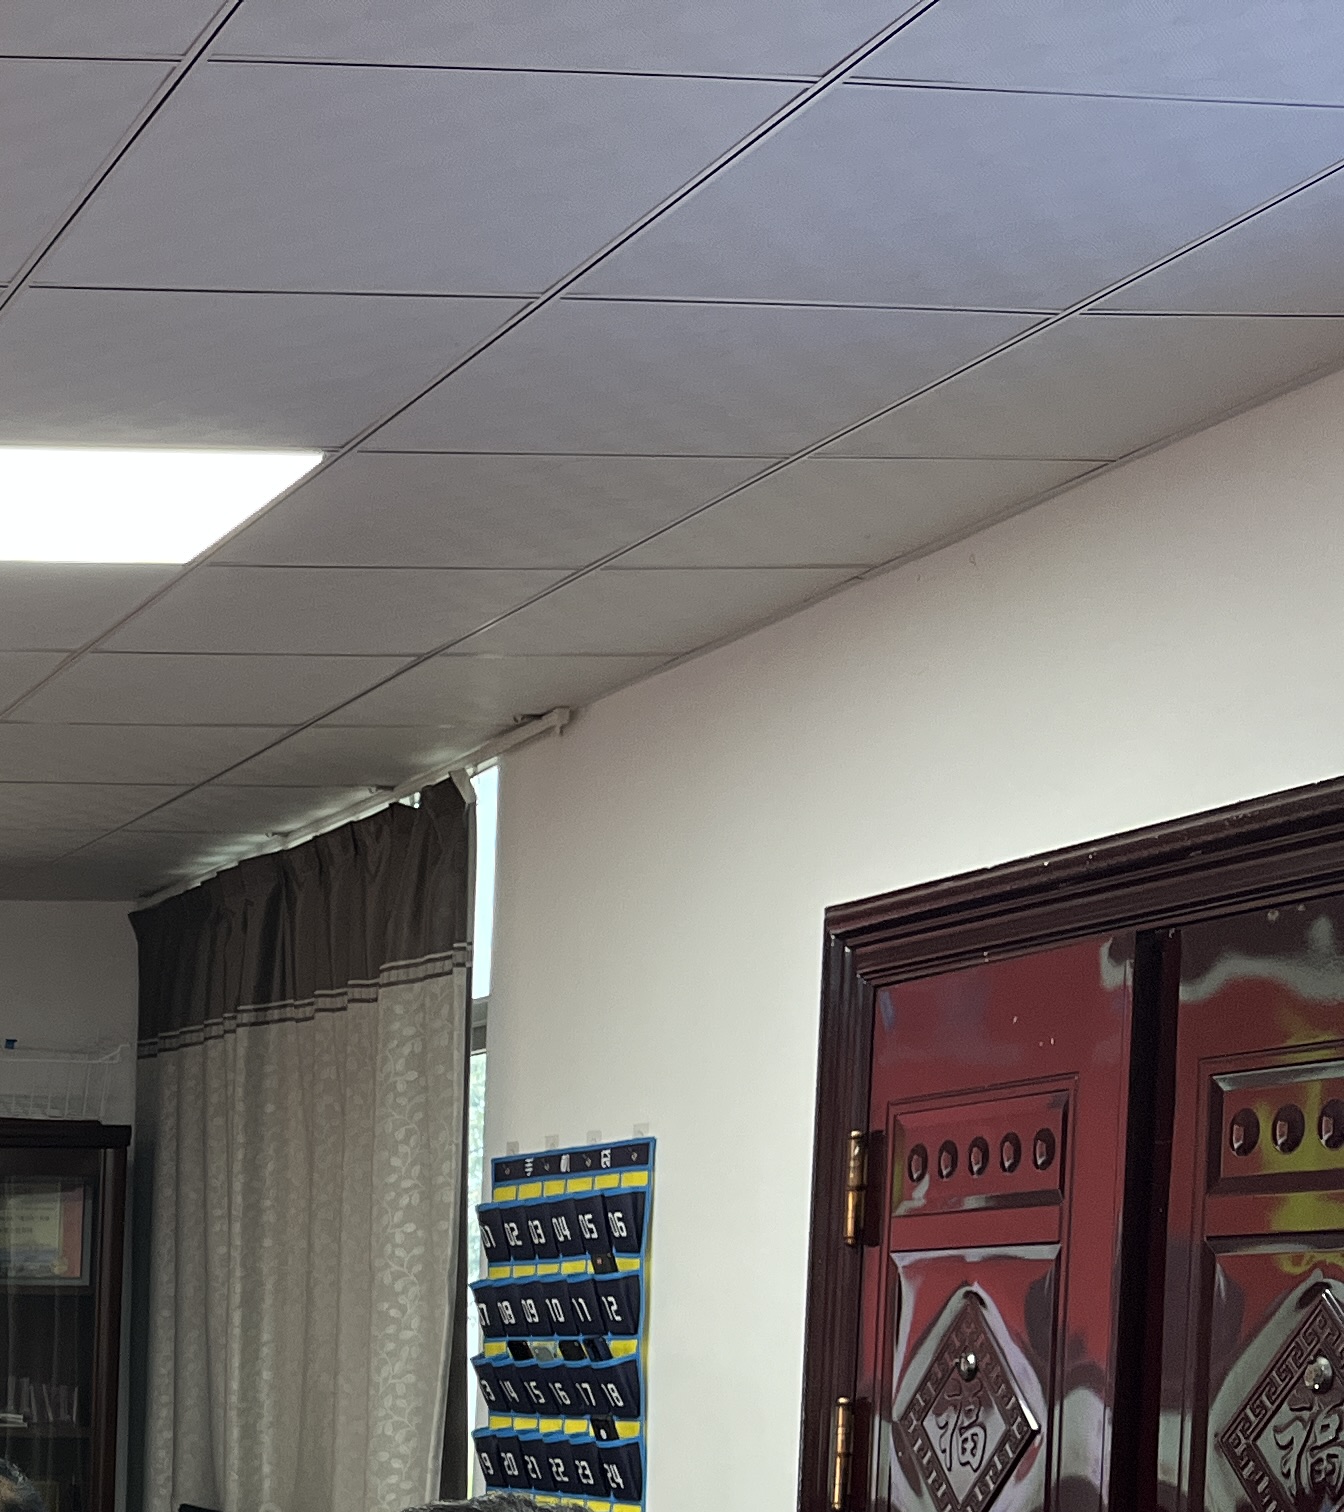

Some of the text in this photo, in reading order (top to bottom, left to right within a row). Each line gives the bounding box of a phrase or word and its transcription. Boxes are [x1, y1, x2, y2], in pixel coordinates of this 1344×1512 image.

[504, 1222, 522, 1246] 02
[528, 1220, 545, 1244] 03
[552, 1216, 571, 1242] 04
[578, 1213, 598, 1239] 05
[607, 1211, 627, 1238] 06
[497, 1300, 516, 1325] 08
[521, 1299, 539, 1323] 09
[545, 1298, 565, 1322] 10
[572, 1297, 592, 1322] 11
[602, 1296, 622, 1322] 12
[499, 1380, 519, 1402] 14
[524, 1381, 545, 1403] 15
[548, 1382, 570, 1404] 16
[575, 1382, 596, 1406] 17
[601, 1383, 624, 1407] 18
[501, 1452, 518, 1476] 20
[525, 1455, 542, 1479] 21
[548, 1458, 569, 1482] 22
[575, 1460, 594, 1484] 23
[604, 1463, 624, 1489] 24
